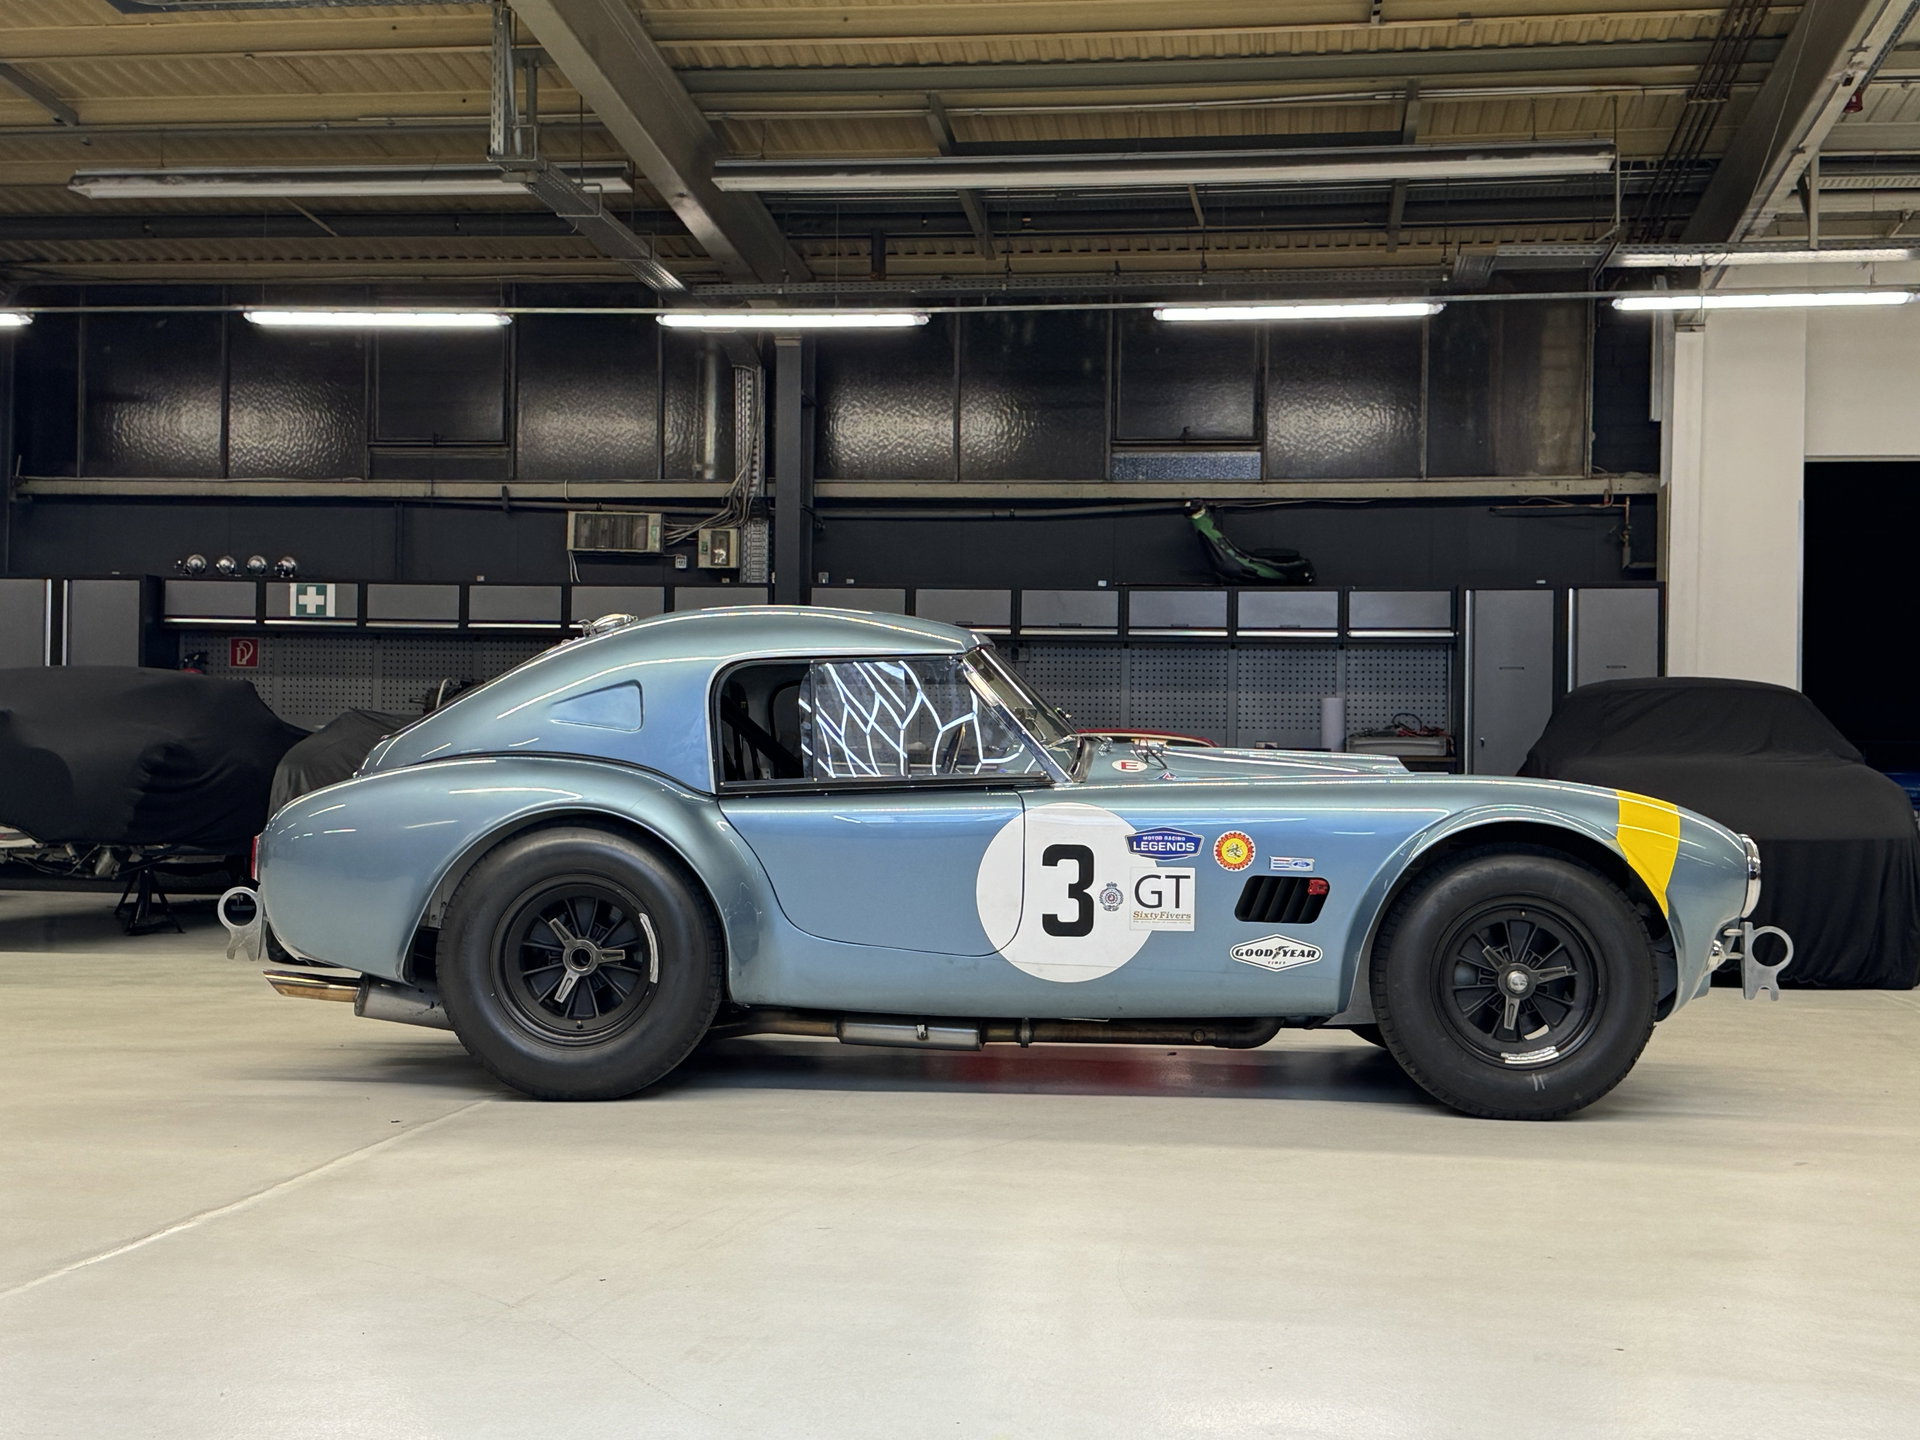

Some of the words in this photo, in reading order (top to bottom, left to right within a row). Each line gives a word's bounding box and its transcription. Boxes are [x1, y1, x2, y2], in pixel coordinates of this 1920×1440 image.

[1120, 761, 1140, 770] E
[1133, 841, 1195, 851] LEGENDS
[1041, 843, 1095, 938] 3
[1134, 874, 1191, 909] GT
[1132, 911, 1192, 921] SixtyFivers
